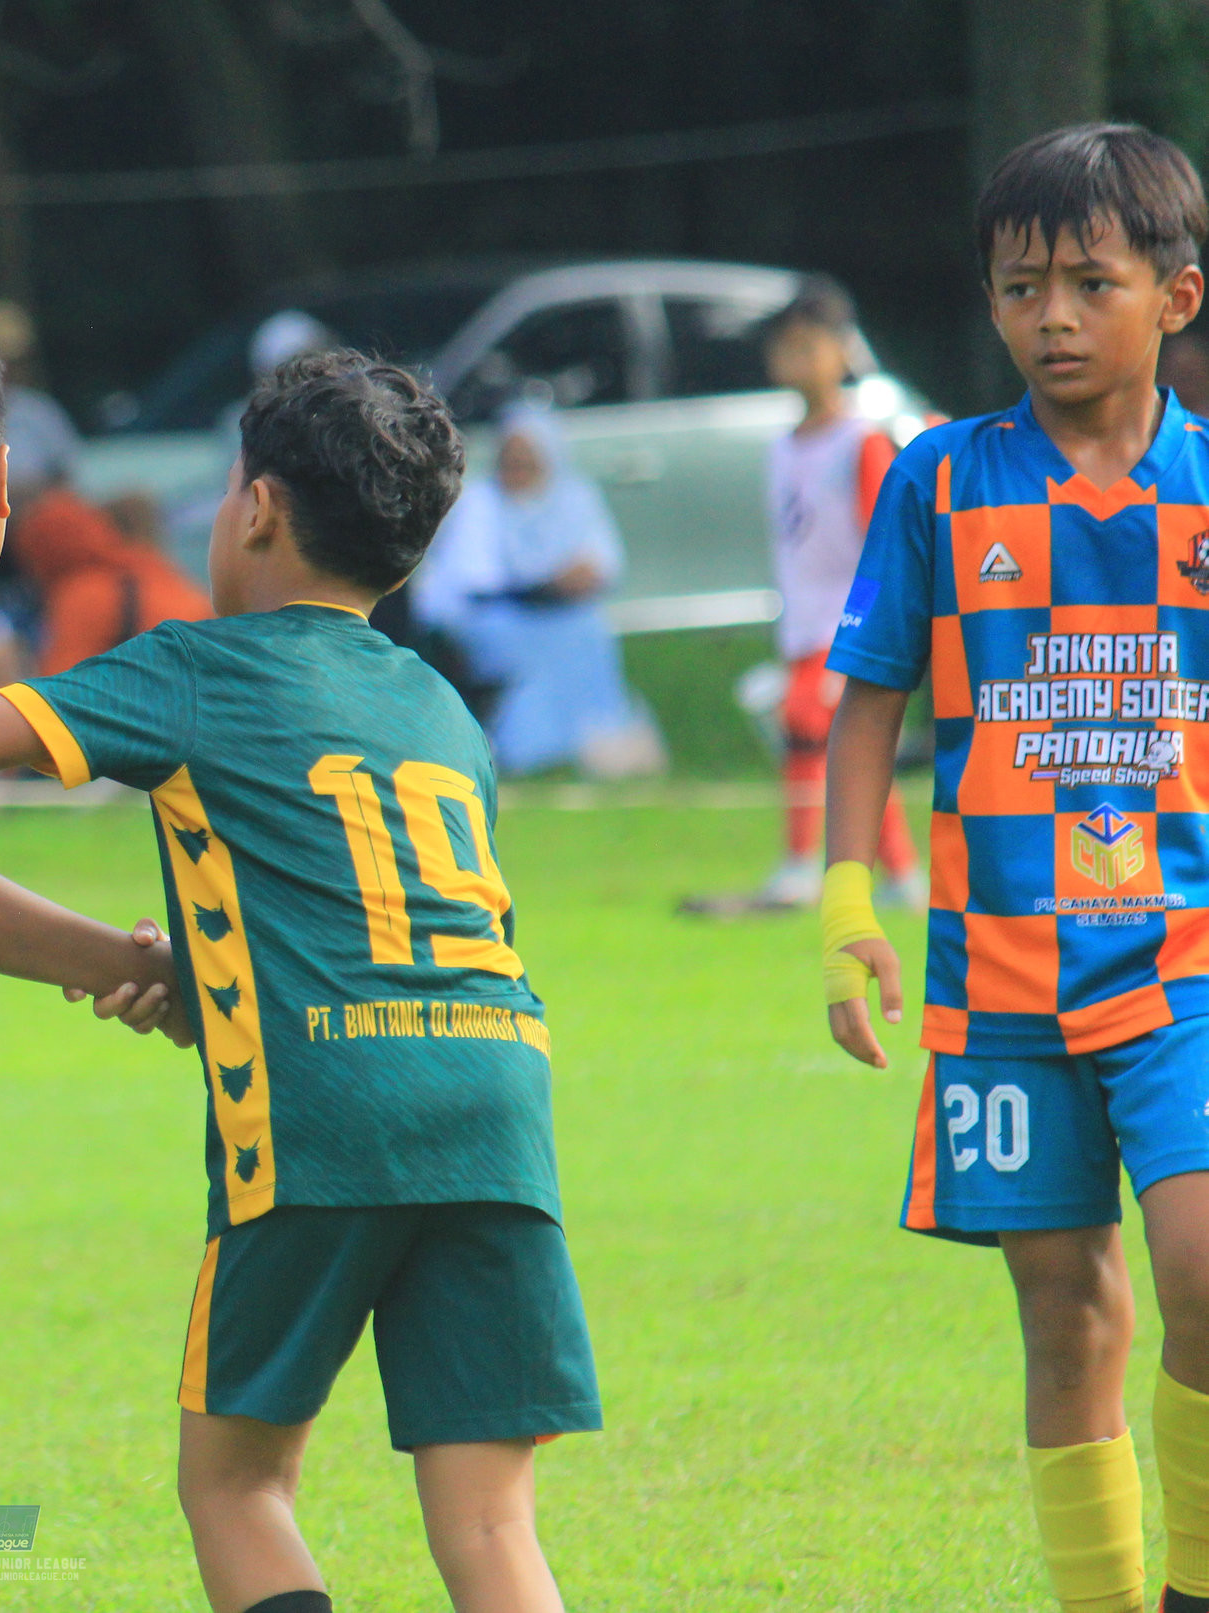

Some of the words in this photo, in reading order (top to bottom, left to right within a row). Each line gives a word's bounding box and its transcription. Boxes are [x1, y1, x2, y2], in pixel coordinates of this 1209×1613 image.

[1027, 633, 1178, 676] JAKARTA
[977, 679, 1114, 721] ACADEMY
[1120, 679, 1209, 722] SOCCER
[1058, 767, 1111, 788] Speed
[1114, 766, 1161, 789] Shop
[308, 754, 525, 982] 19
[1070, 826, 1146, 890] CMS
[1059, 896, 1118, 911] CAHAYA
[1076, 910, 1148, 927] SELARAS
[306, 1006, 339, 1042] PT.
[344, 1000, 426, 1039] BINTANG
[430, 1002, 519, 1042] OLAHRAGA
[943, 1083, 1030, 1172] 20
